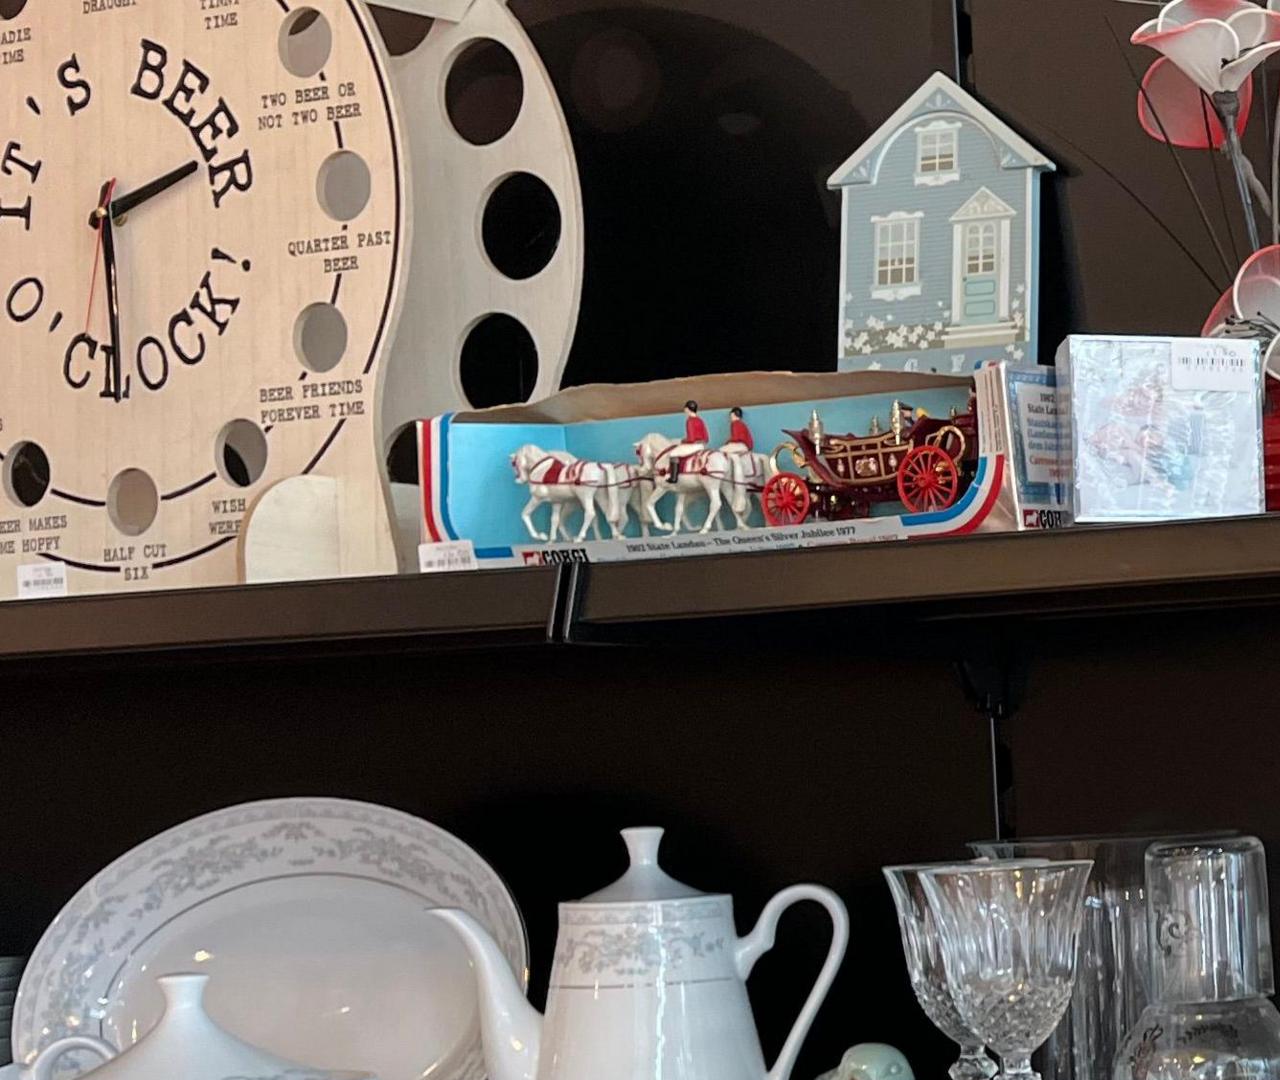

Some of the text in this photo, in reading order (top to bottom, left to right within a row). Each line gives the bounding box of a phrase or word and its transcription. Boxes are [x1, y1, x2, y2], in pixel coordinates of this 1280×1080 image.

[204, 12, 239, 30] TIME
[261, 82, 356, 109] TWO BEER OR
[258, 103, 362, 130] NOT TWO BEER
[0, 38, 253, 399] IT'S BEER O'CLOCK!
[287, 231, 392, 257] QUARTER PAST
[323, 256, 359, 273] BEER
[259, 379, 363, 403] BEER FRIENDS
[260, 401, 365, 424] FOREVER TIME
[212, 498, 247, 514] WISH
[29, 515, 68, 531] MAKES
[22, 536, 61, 553] HOPPY
[714, 536, 731, 546] The
[732, 533, 769, 545] Queen's
[771, 531, 799, 542] Silver
[801, 528, 834, 540] Jubilee
[103, 544, 167, 563] HALF CUT
[543, 549, 590, 563] CORGI
[124, 566, 149, 581] SIX
